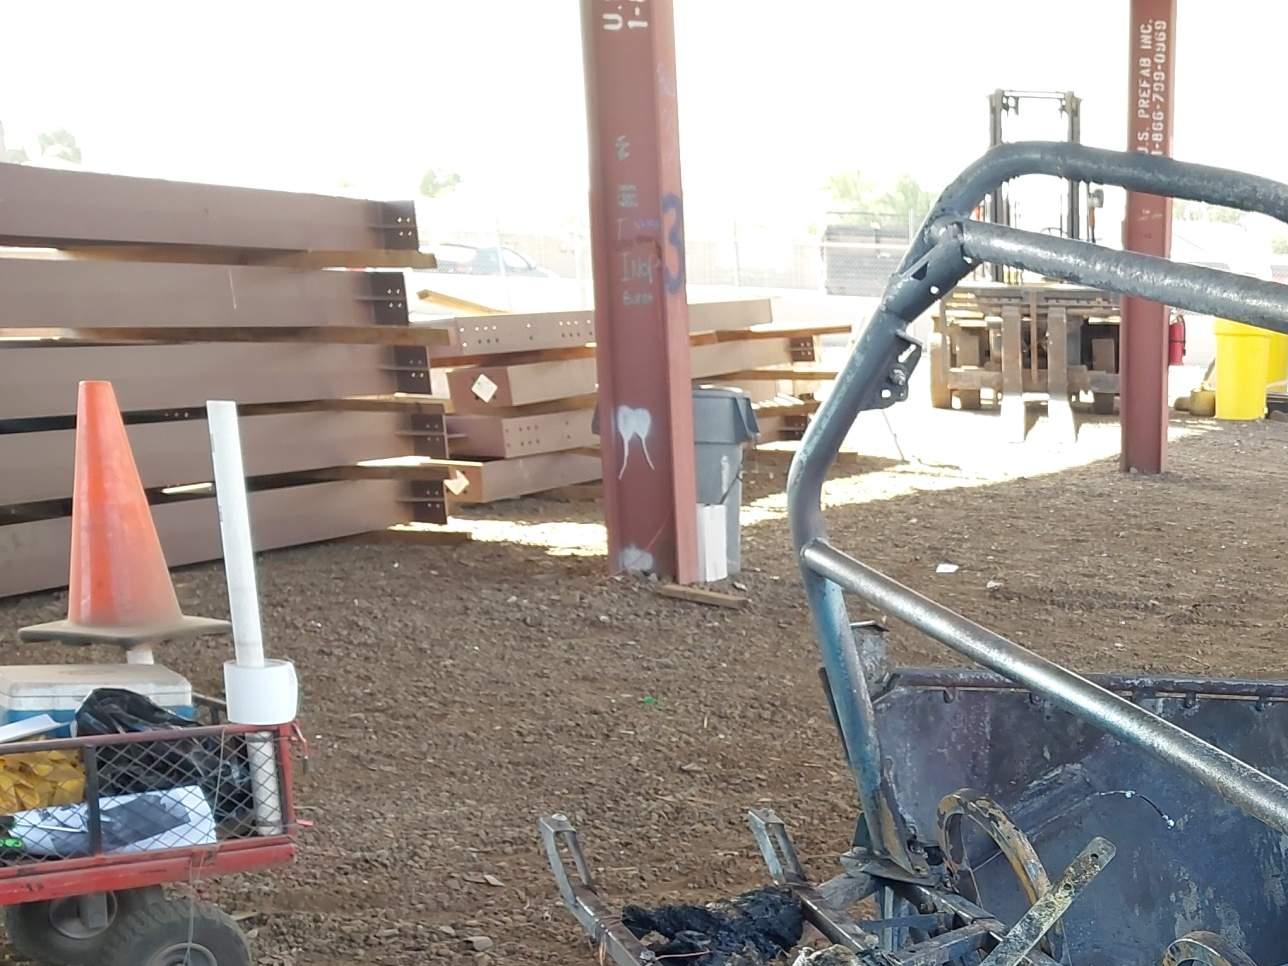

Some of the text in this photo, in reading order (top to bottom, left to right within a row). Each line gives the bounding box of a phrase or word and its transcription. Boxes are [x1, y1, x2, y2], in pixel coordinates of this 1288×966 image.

[602, 0, 623, 30] U.
[627, 0, 648, 29] 1-
[1140, 18, 1153, 50] INC.
[1137, 57, 1152, 119] PREFAB
[1151, 20, 1168, 156] 1-866-799-0969
